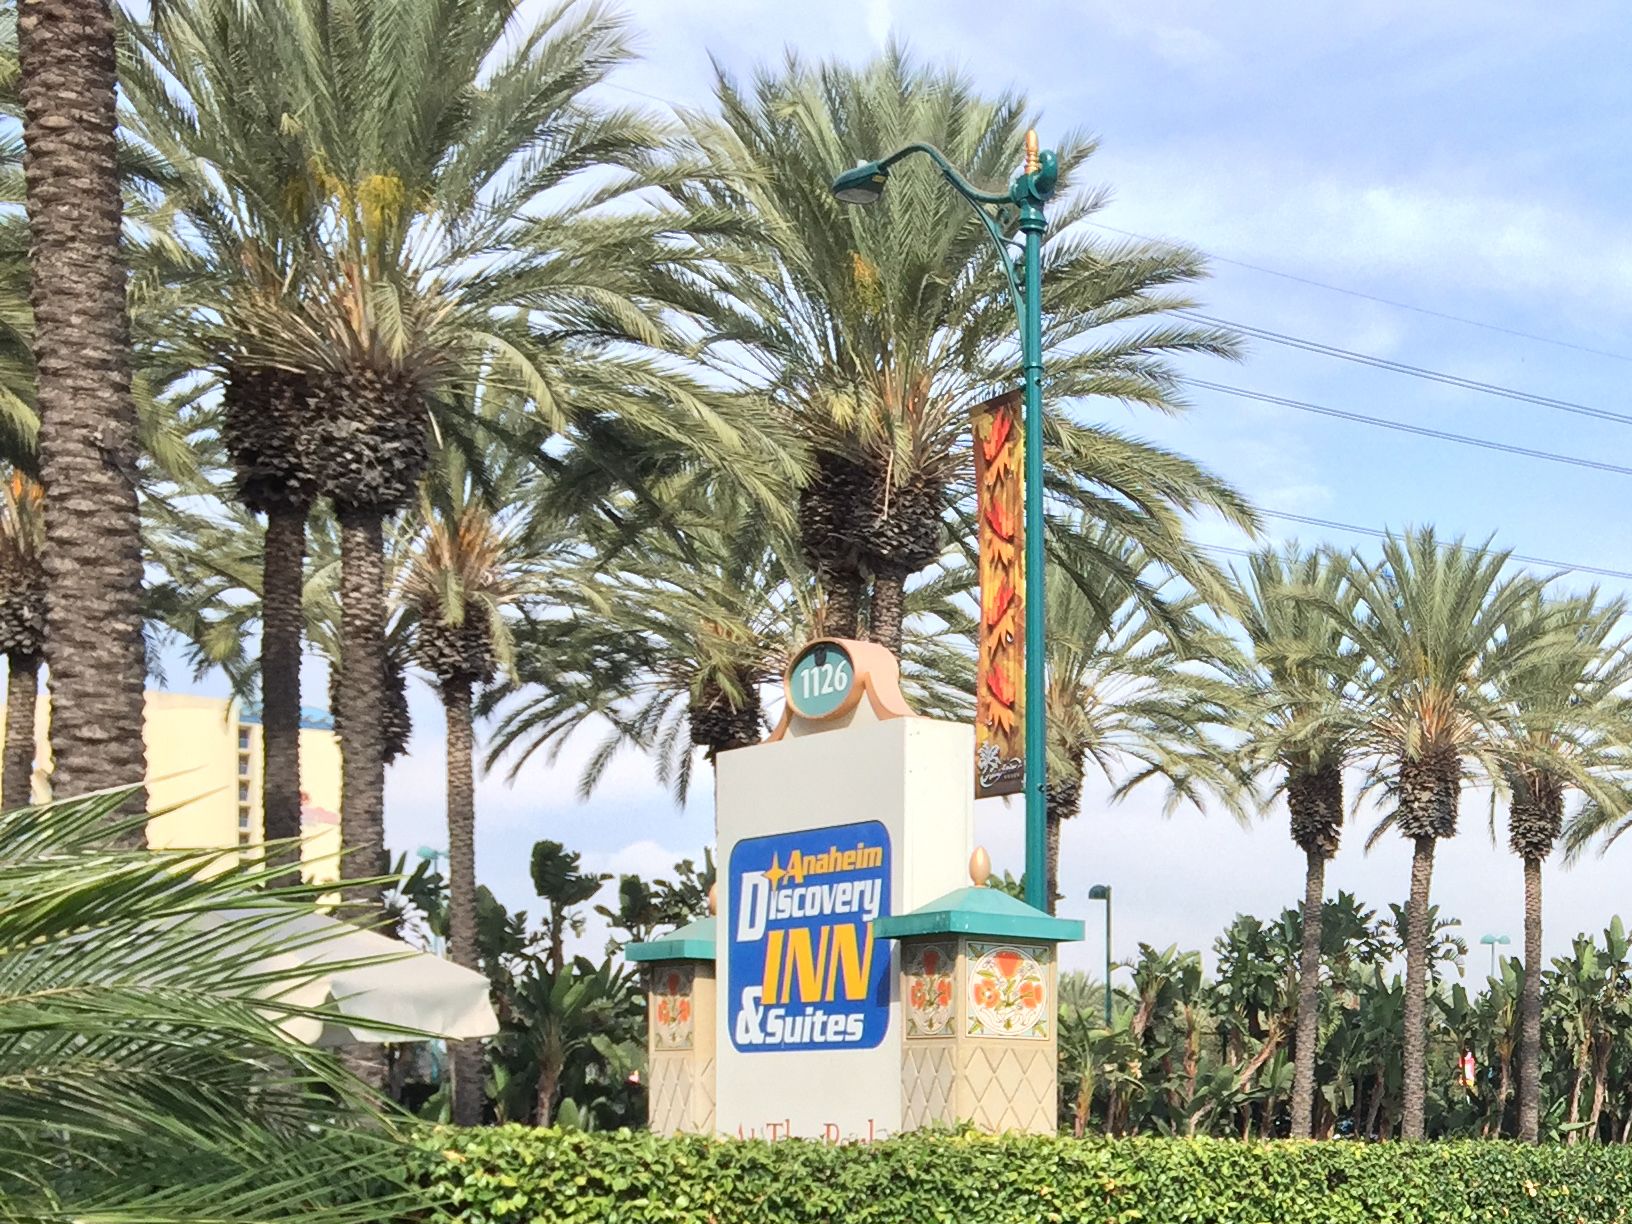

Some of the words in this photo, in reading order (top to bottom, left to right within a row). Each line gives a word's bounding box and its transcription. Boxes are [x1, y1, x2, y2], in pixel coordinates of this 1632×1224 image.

[801, 660, 848, 698] 1126
[782, 842, 882, 885] Anaheim
[736, 870, 882, 942] Discovery
[760, 921, 875, 1005] INN
